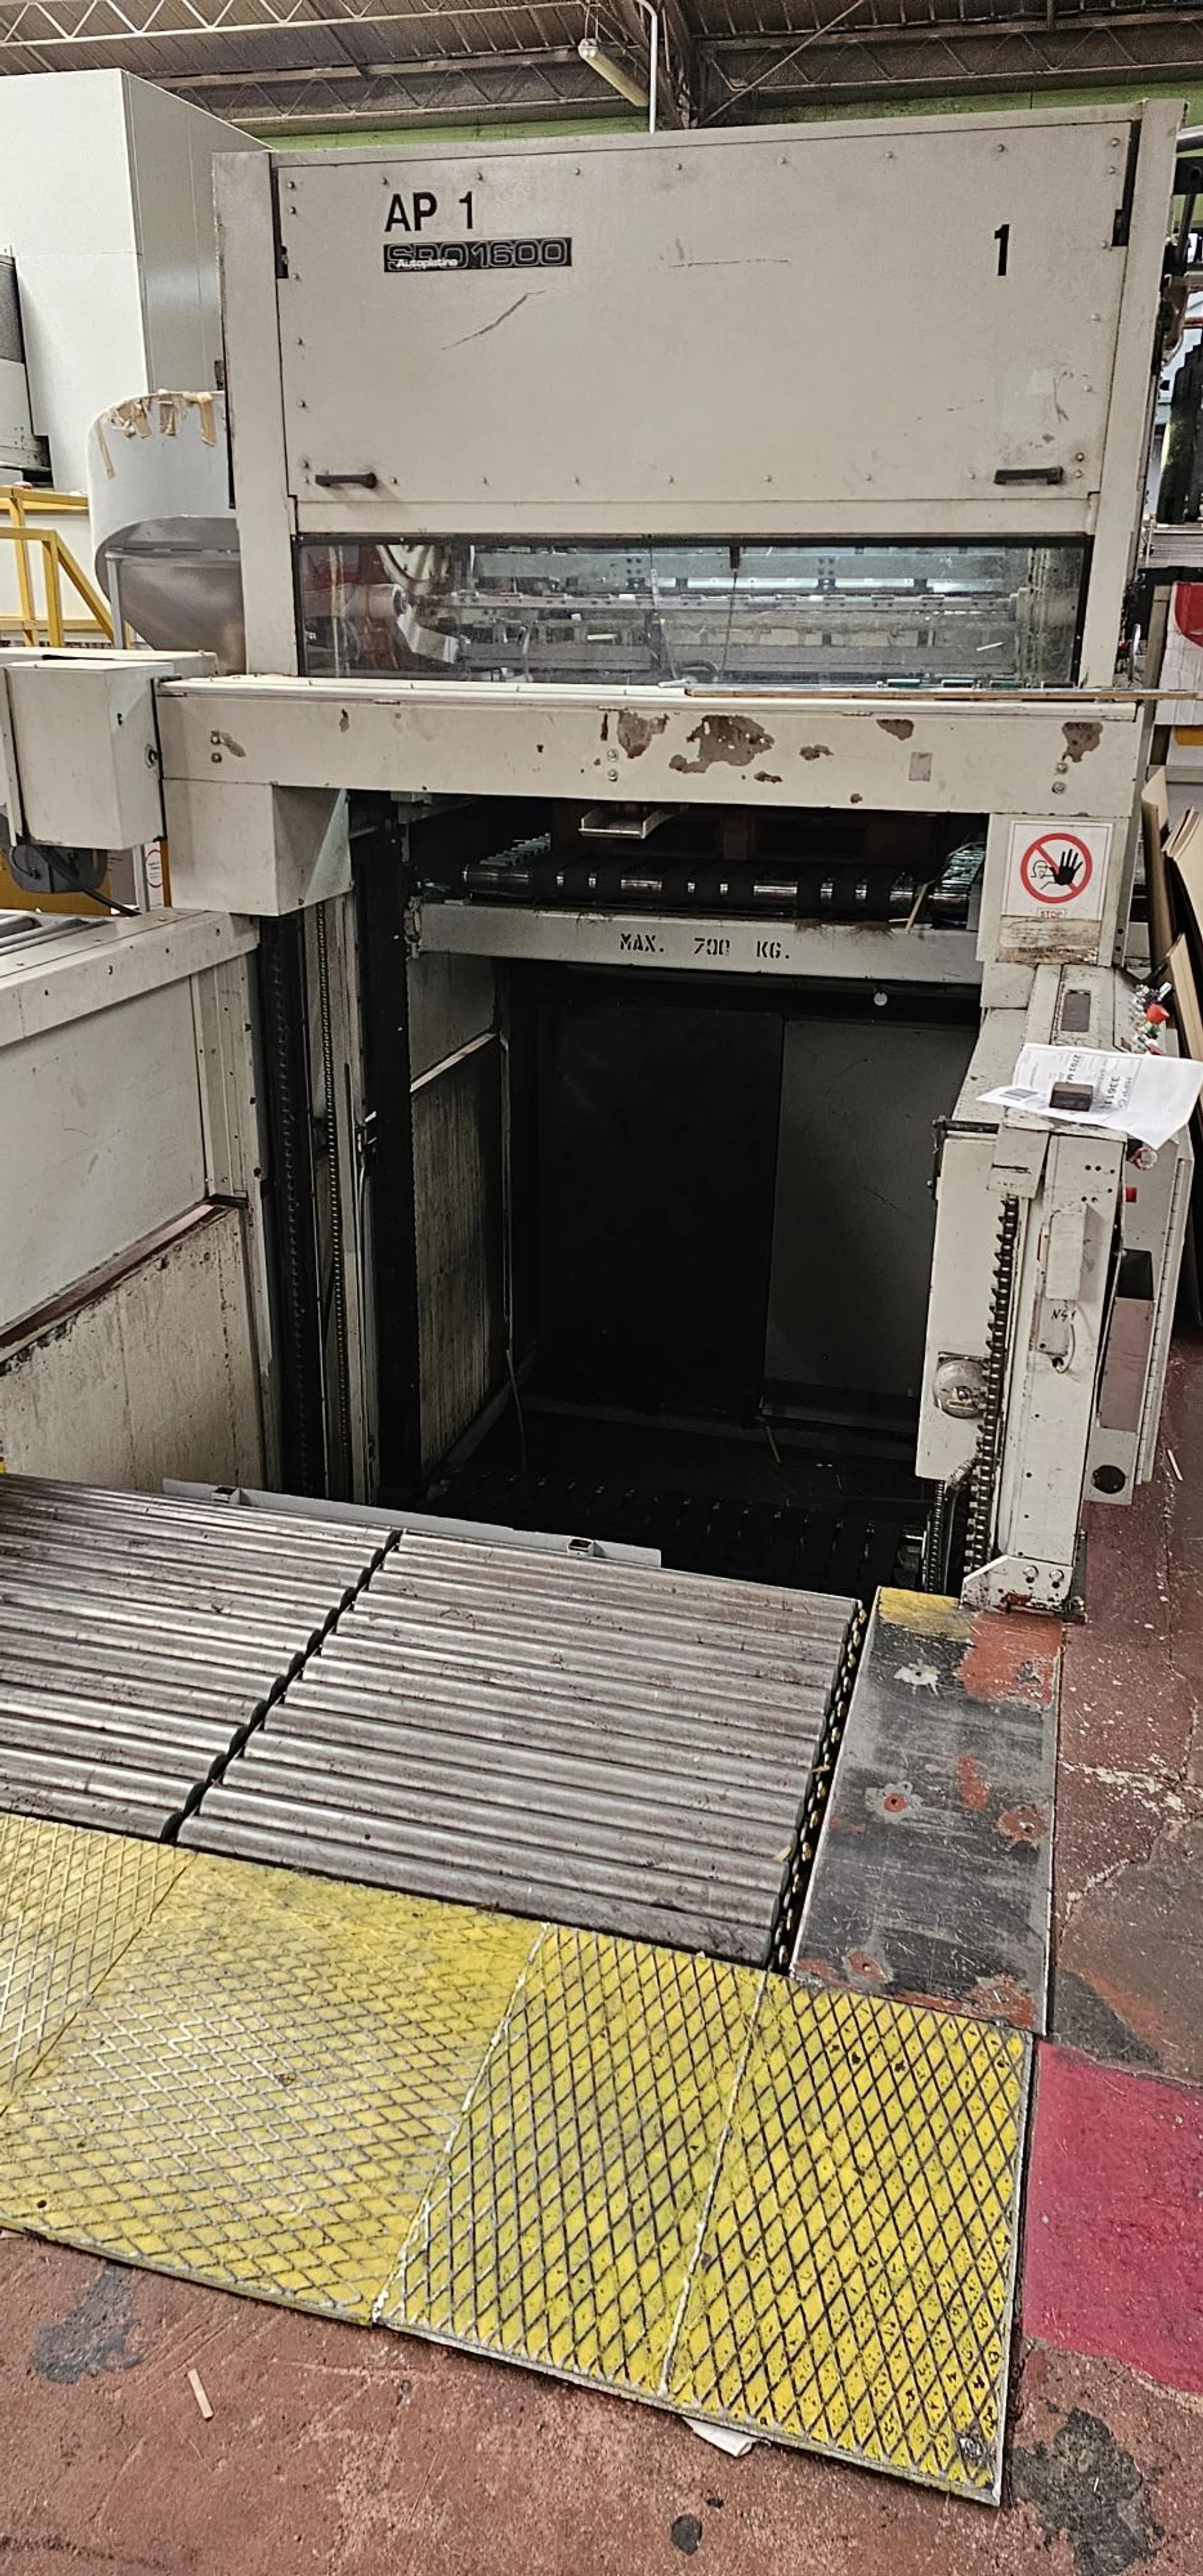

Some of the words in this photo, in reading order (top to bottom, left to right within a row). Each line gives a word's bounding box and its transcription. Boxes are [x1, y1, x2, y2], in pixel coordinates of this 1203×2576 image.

[385, 192, 438, 232] AP
[459, 191, 473, 229] 1
[994, 224, 1010, 276] 1
[1040, 910, 1063, 920] STOP
[620, 933, 664, 953] MAX.
[694, 937, 730, 956] 700
[756, 940, 790, 959] KG.
